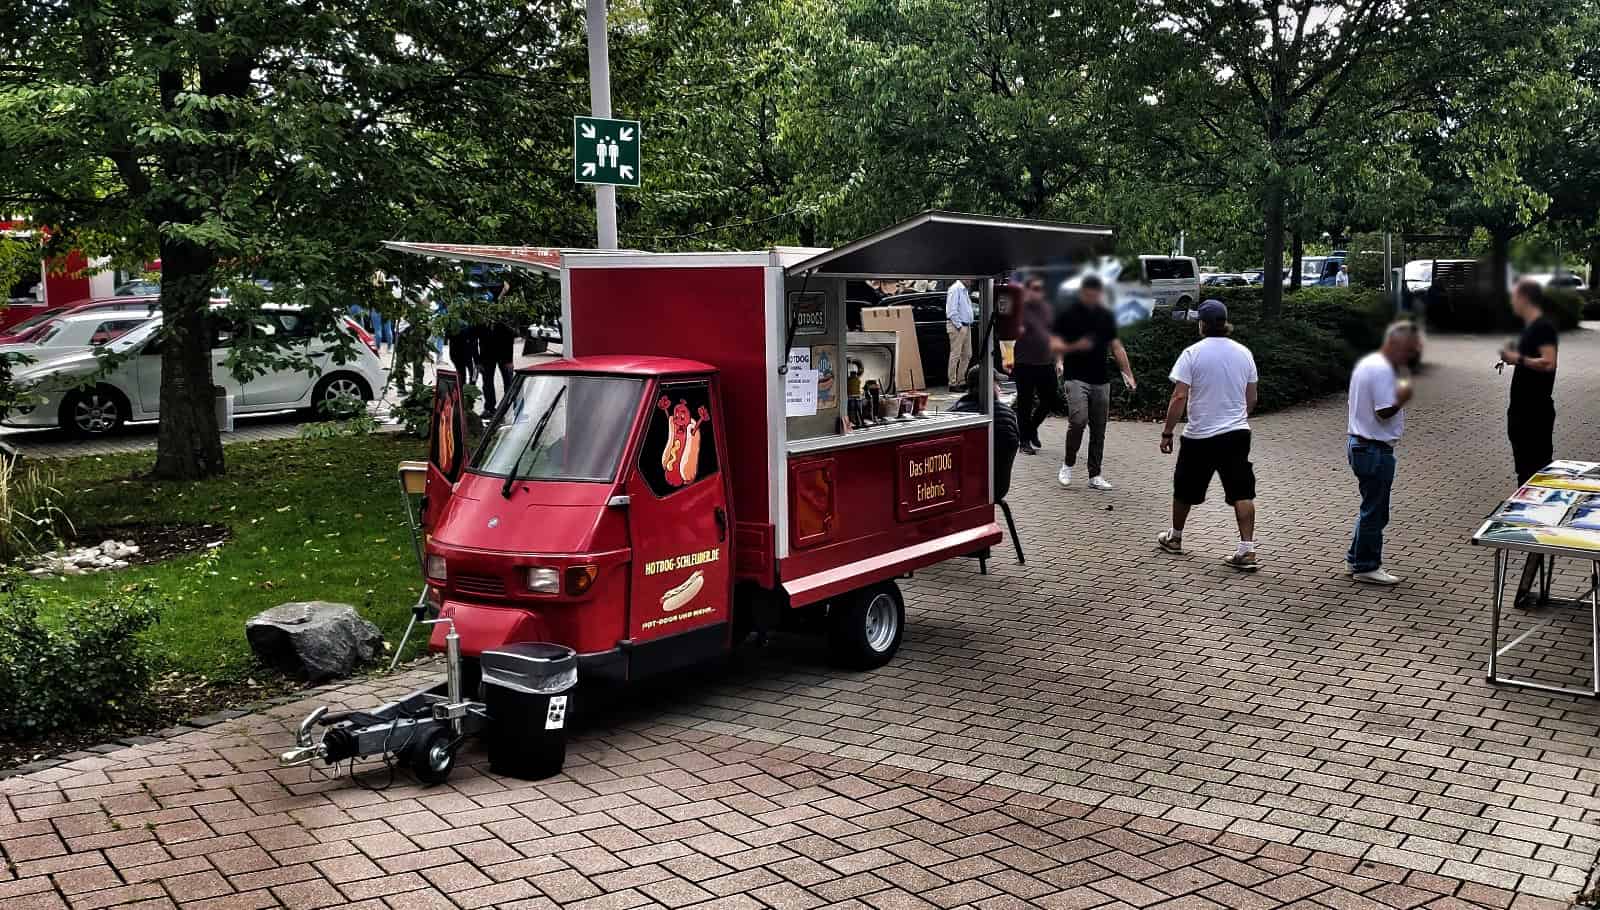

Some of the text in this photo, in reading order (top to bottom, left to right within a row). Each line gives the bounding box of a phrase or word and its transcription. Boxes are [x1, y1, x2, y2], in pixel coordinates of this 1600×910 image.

[793, 311, 823, 325] OTDOGS
[909, 452, 952, 478] Das HOTDOG
[917, 480, 945, 501] Erlebnis
[645, 548, 720, 575] HOTDOG-SCHLEUDER.DE
